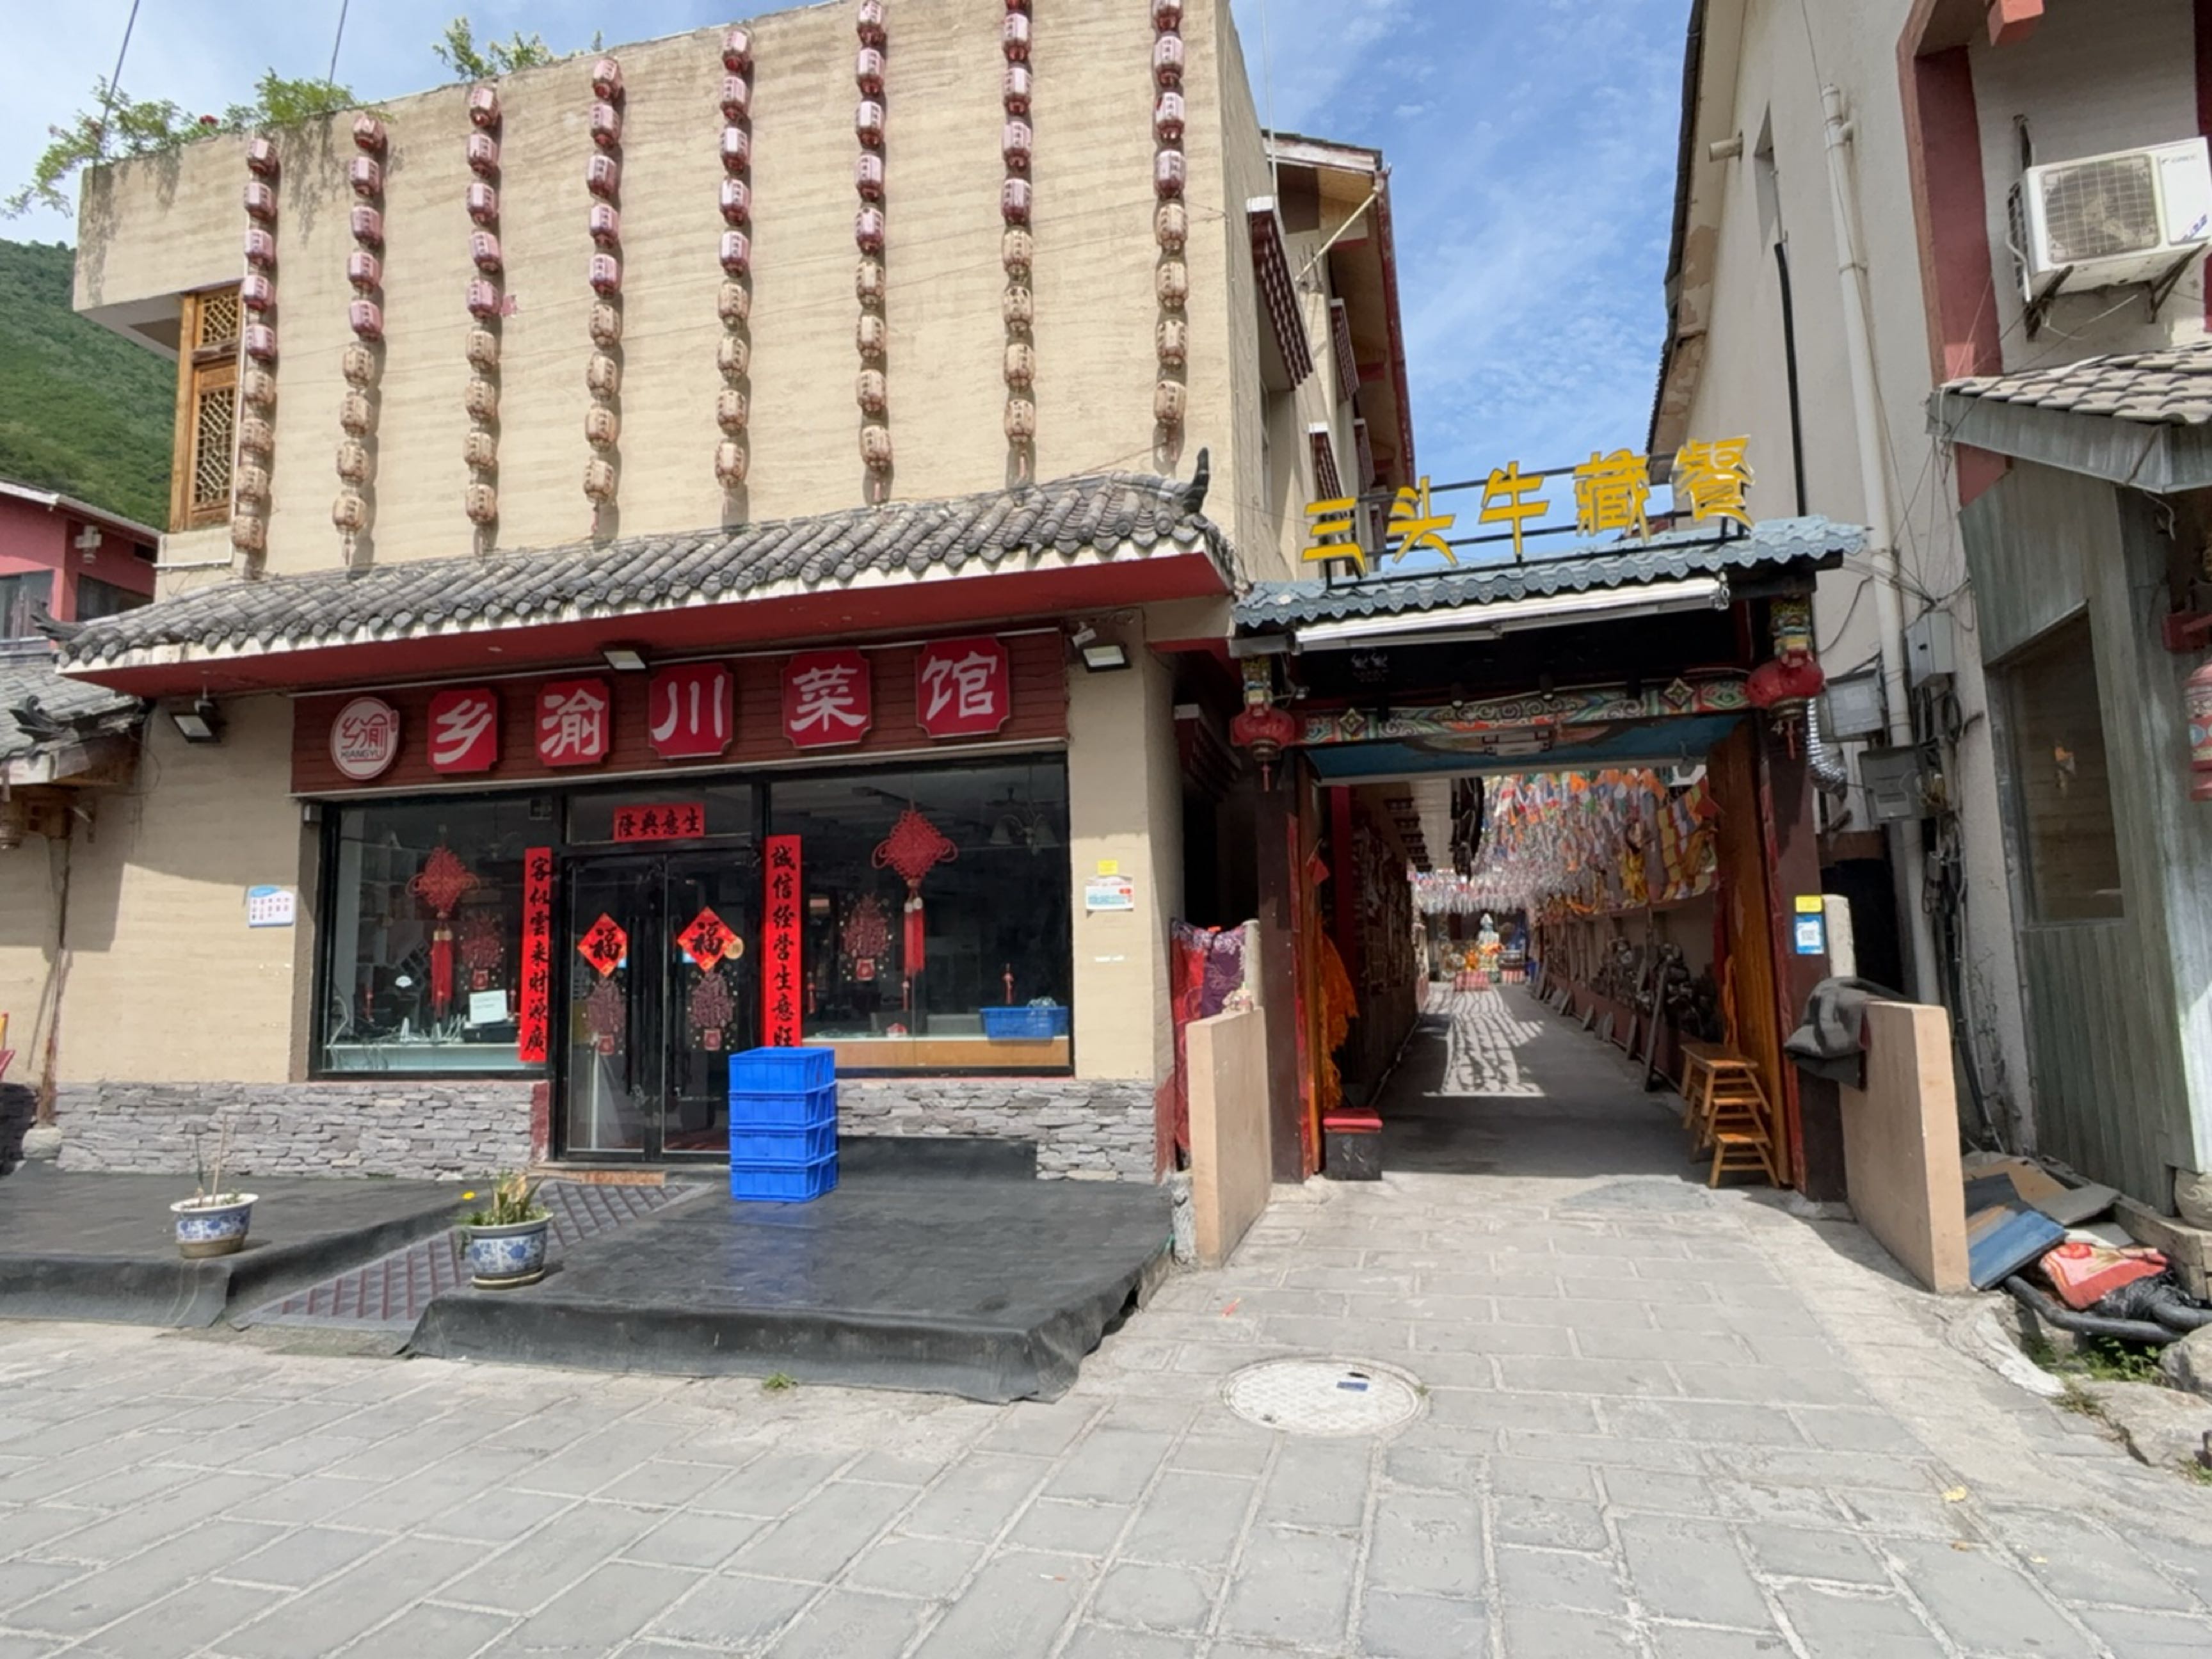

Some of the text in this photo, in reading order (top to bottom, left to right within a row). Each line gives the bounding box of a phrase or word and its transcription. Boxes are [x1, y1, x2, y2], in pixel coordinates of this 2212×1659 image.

[1301, 435, 1756, 575] 三头牛藏餐
[433, 650, 998, 765] 乡渝川菜馆
[589, 927, 621, 959] 福
[689, 921, 724, 956] 福
